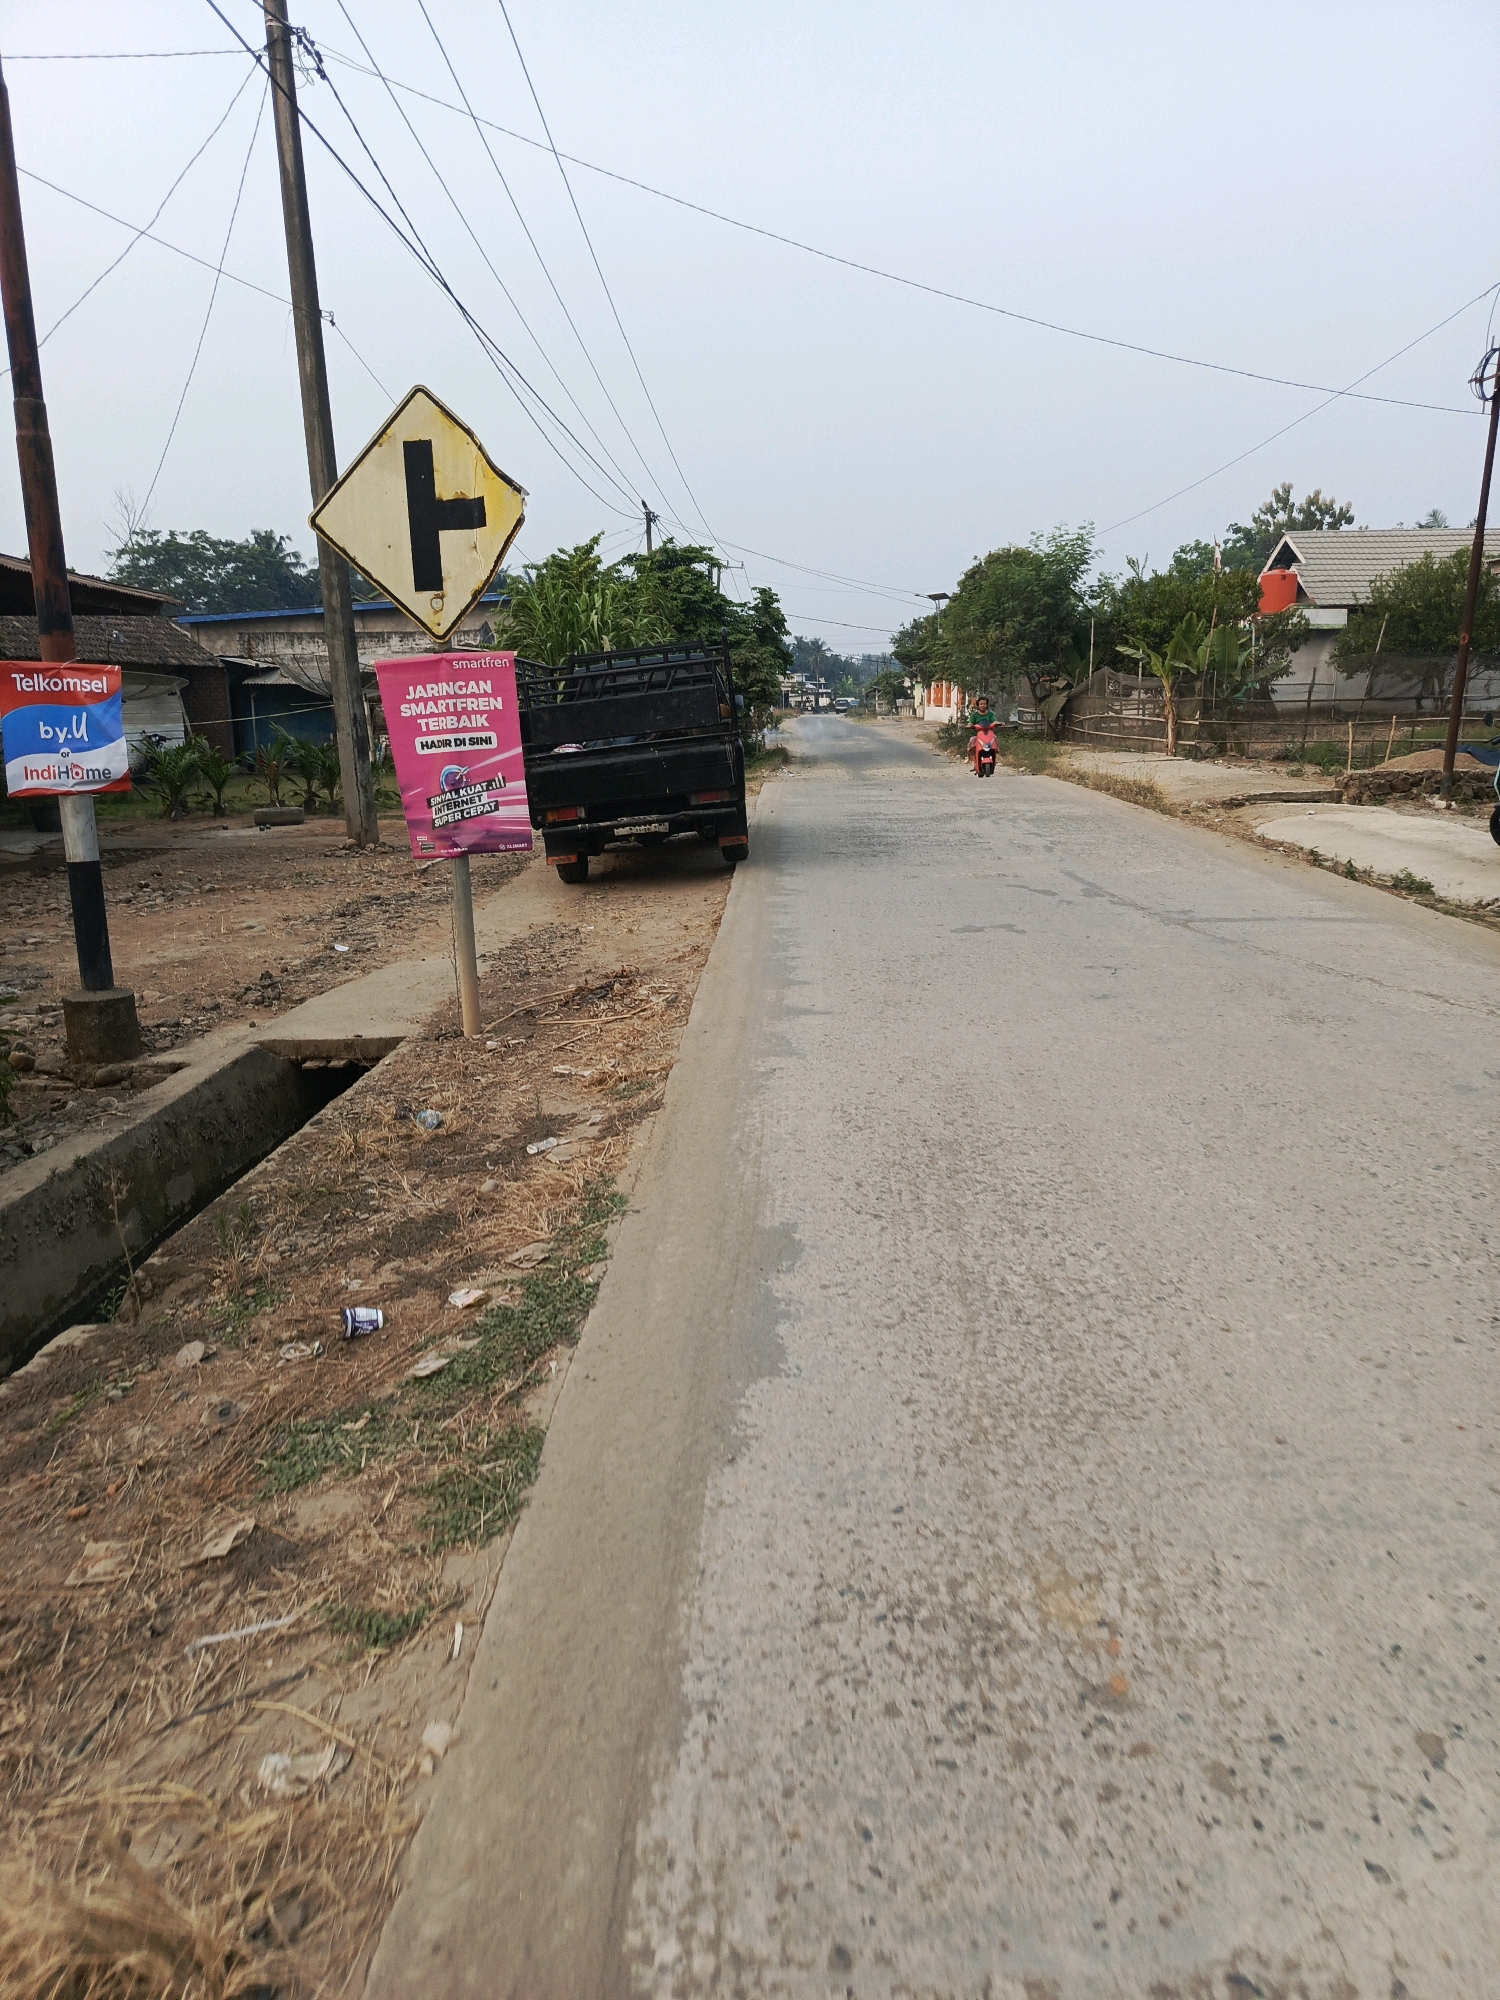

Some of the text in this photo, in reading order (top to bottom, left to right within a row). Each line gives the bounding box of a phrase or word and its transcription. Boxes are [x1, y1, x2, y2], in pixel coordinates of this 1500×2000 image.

[452, 657, 509, 669] smartfren
[11, 673, 107, 693] Telkomsel
[406, 680, 492, 700] JARINGAN
[400, 697, 503, 717] SMARTFREN
[39, 711, 88, 743] by.U
[417, 714, 489, 731] TERBAIK
[60, 750, 70, 758] or
[420, 738, 493, 750] HADIR DI SINI
[24, 763, 111, 780] IndiHome
[430, 782, 488, 806] SINYAL KUAT
[434, 794, 484, 816] INTERNET
[434, 802, 496, 827] SUPER CEPAT
